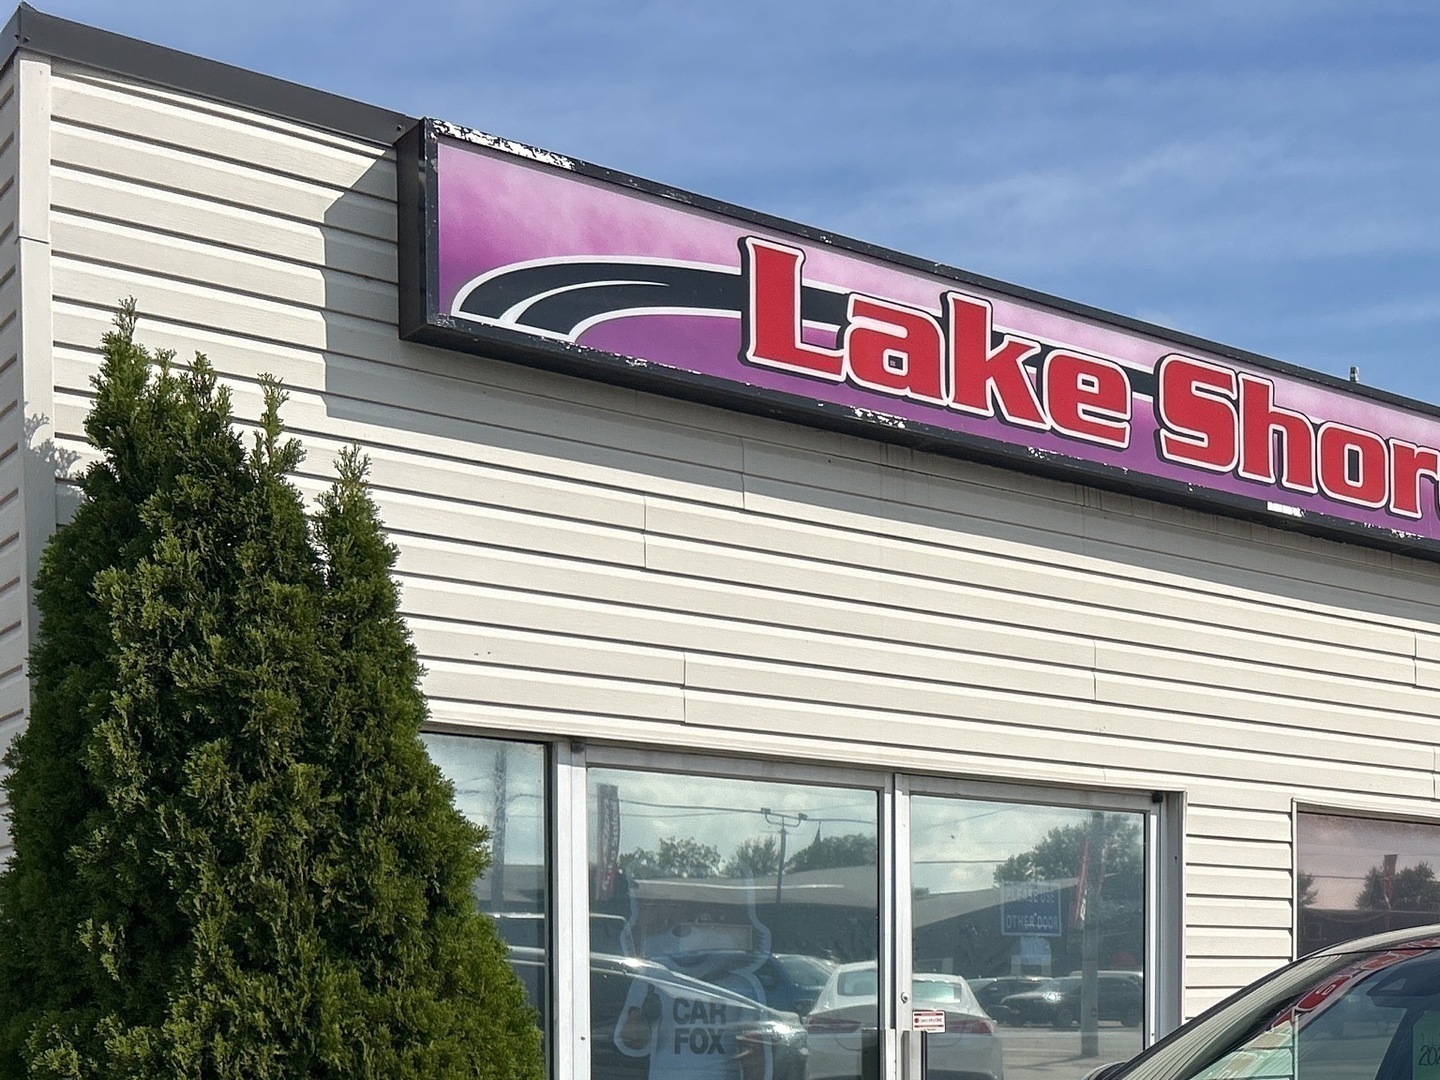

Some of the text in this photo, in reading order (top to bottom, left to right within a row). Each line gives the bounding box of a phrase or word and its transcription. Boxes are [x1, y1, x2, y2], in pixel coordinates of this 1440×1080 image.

[742, 235, 1133, 449] Lake
[1006, 914, 1059, 930] OTHER DOOR
[674, 1027, 726, 1055] FOX
